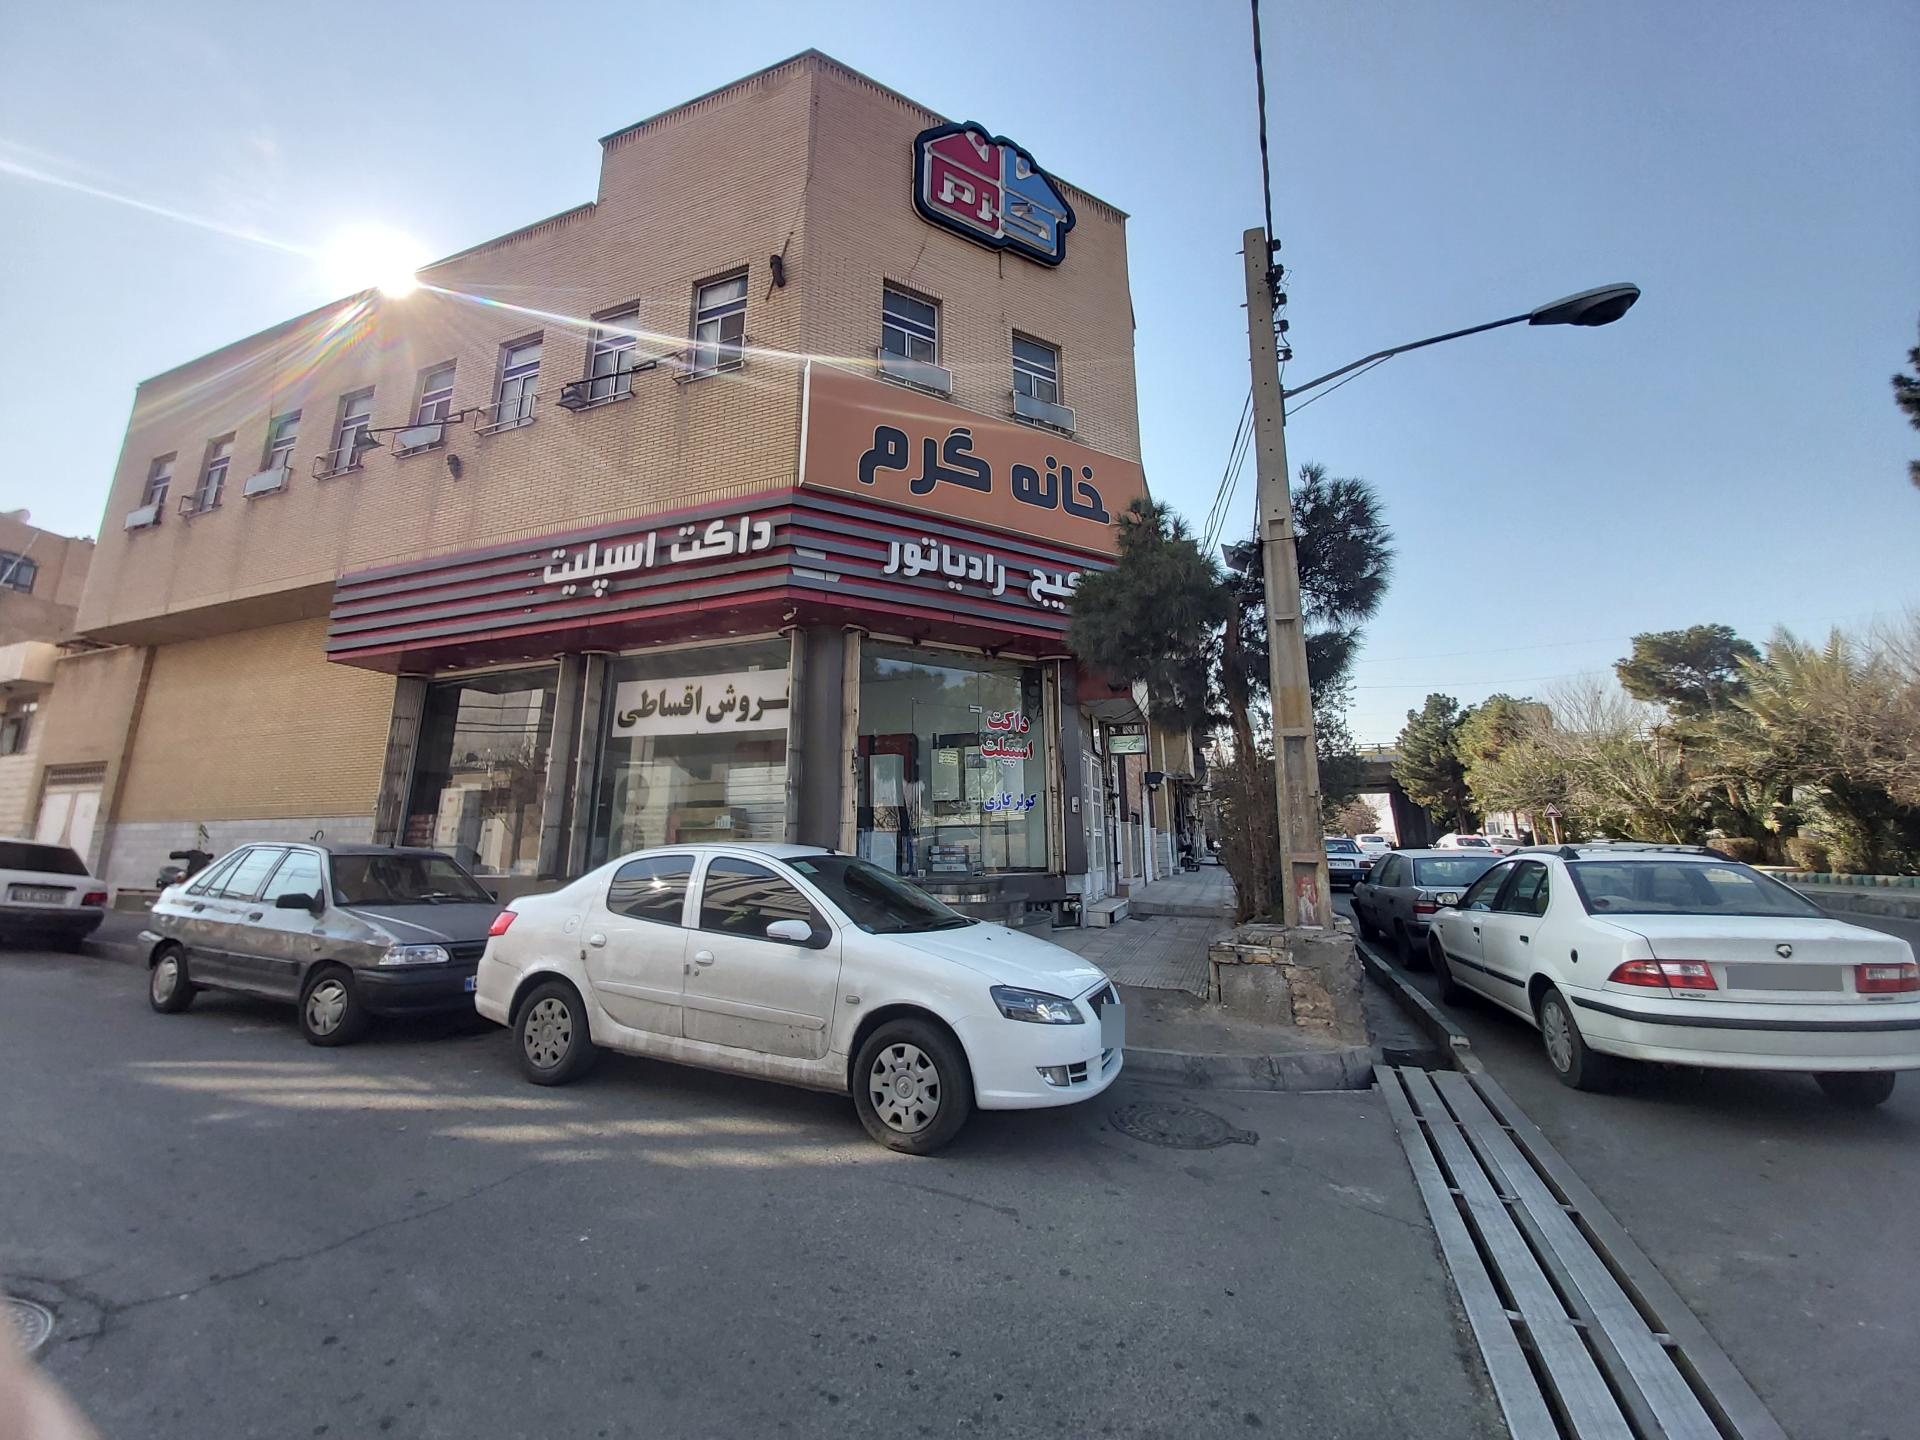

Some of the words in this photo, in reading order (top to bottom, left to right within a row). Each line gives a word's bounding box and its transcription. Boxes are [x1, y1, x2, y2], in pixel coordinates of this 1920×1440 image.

[857, 424, 993, 496] گرم
[1011, 454, 1112, 525] خانه
[670, 515, 772, 563] داکت
[543, 531, 657, 598] اسپلیت
[883, 536, 1006, 596] رادیاتور
[617, 685, 703, 728] اقساطی
[987, 711, 1030, 733] داکت
[980, 736, 1035, 768] اسپیلت
[1013, 791, 1037, 813] کولر
